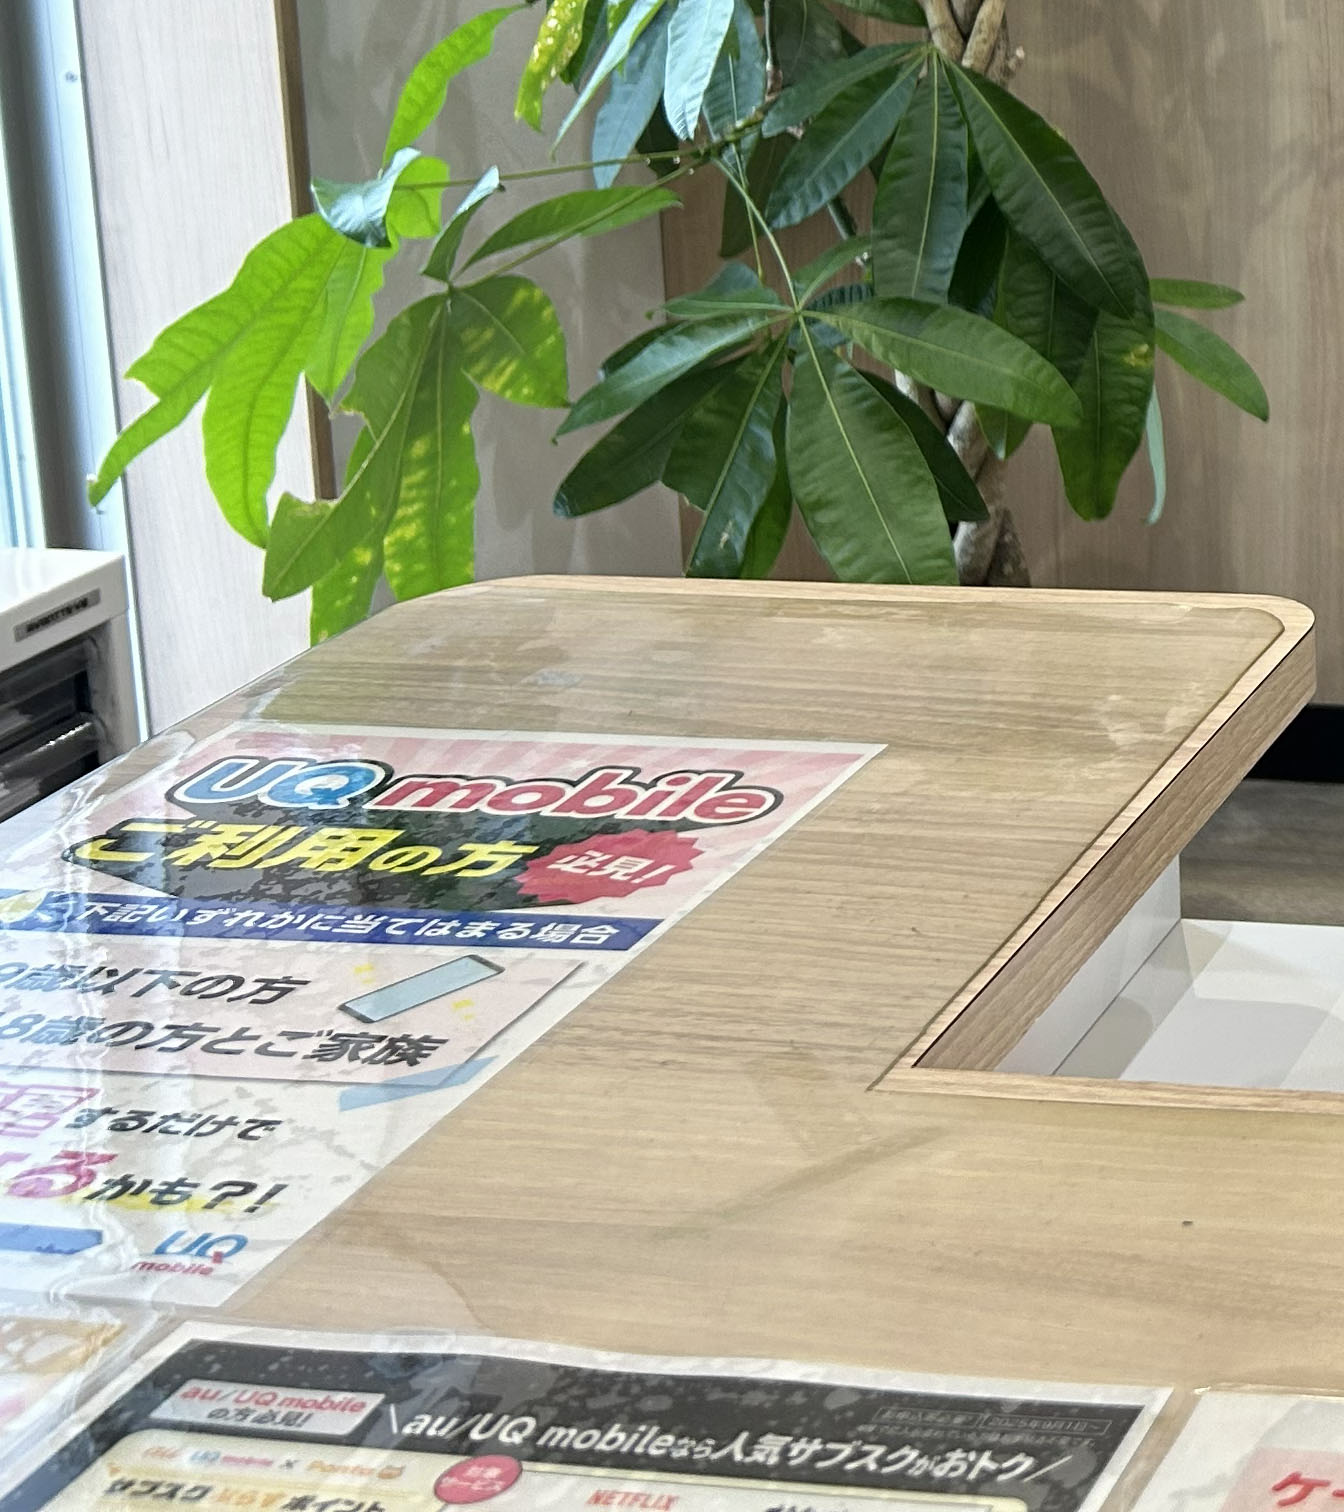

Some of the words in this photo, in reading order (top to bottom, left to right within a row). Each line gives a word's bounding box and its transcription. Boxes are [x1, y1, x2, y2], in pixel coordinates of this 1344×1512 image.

[176, 758, 388, 808] UQ
[370, 768, 770, 822] mobile
[73, 820, 541, 878] ご利用の方
[546, 848, 677, 884] 必見!
[76, 901, 620, 944] 下記いずれかに当てはまる場合
[0, 1013, 449, 1067] 8歳の方とご家族
[154, 1230, 249, 1264] UQ
[130, 1260, 216, 1276] mobile
[180, 1386, 279, 1407] au/UQ
[278, 1394, 367, 1413] mobile
[401, 1412, 538, 1445] au/UQ
[585, 1489, 680, 1512] NETFLIX
